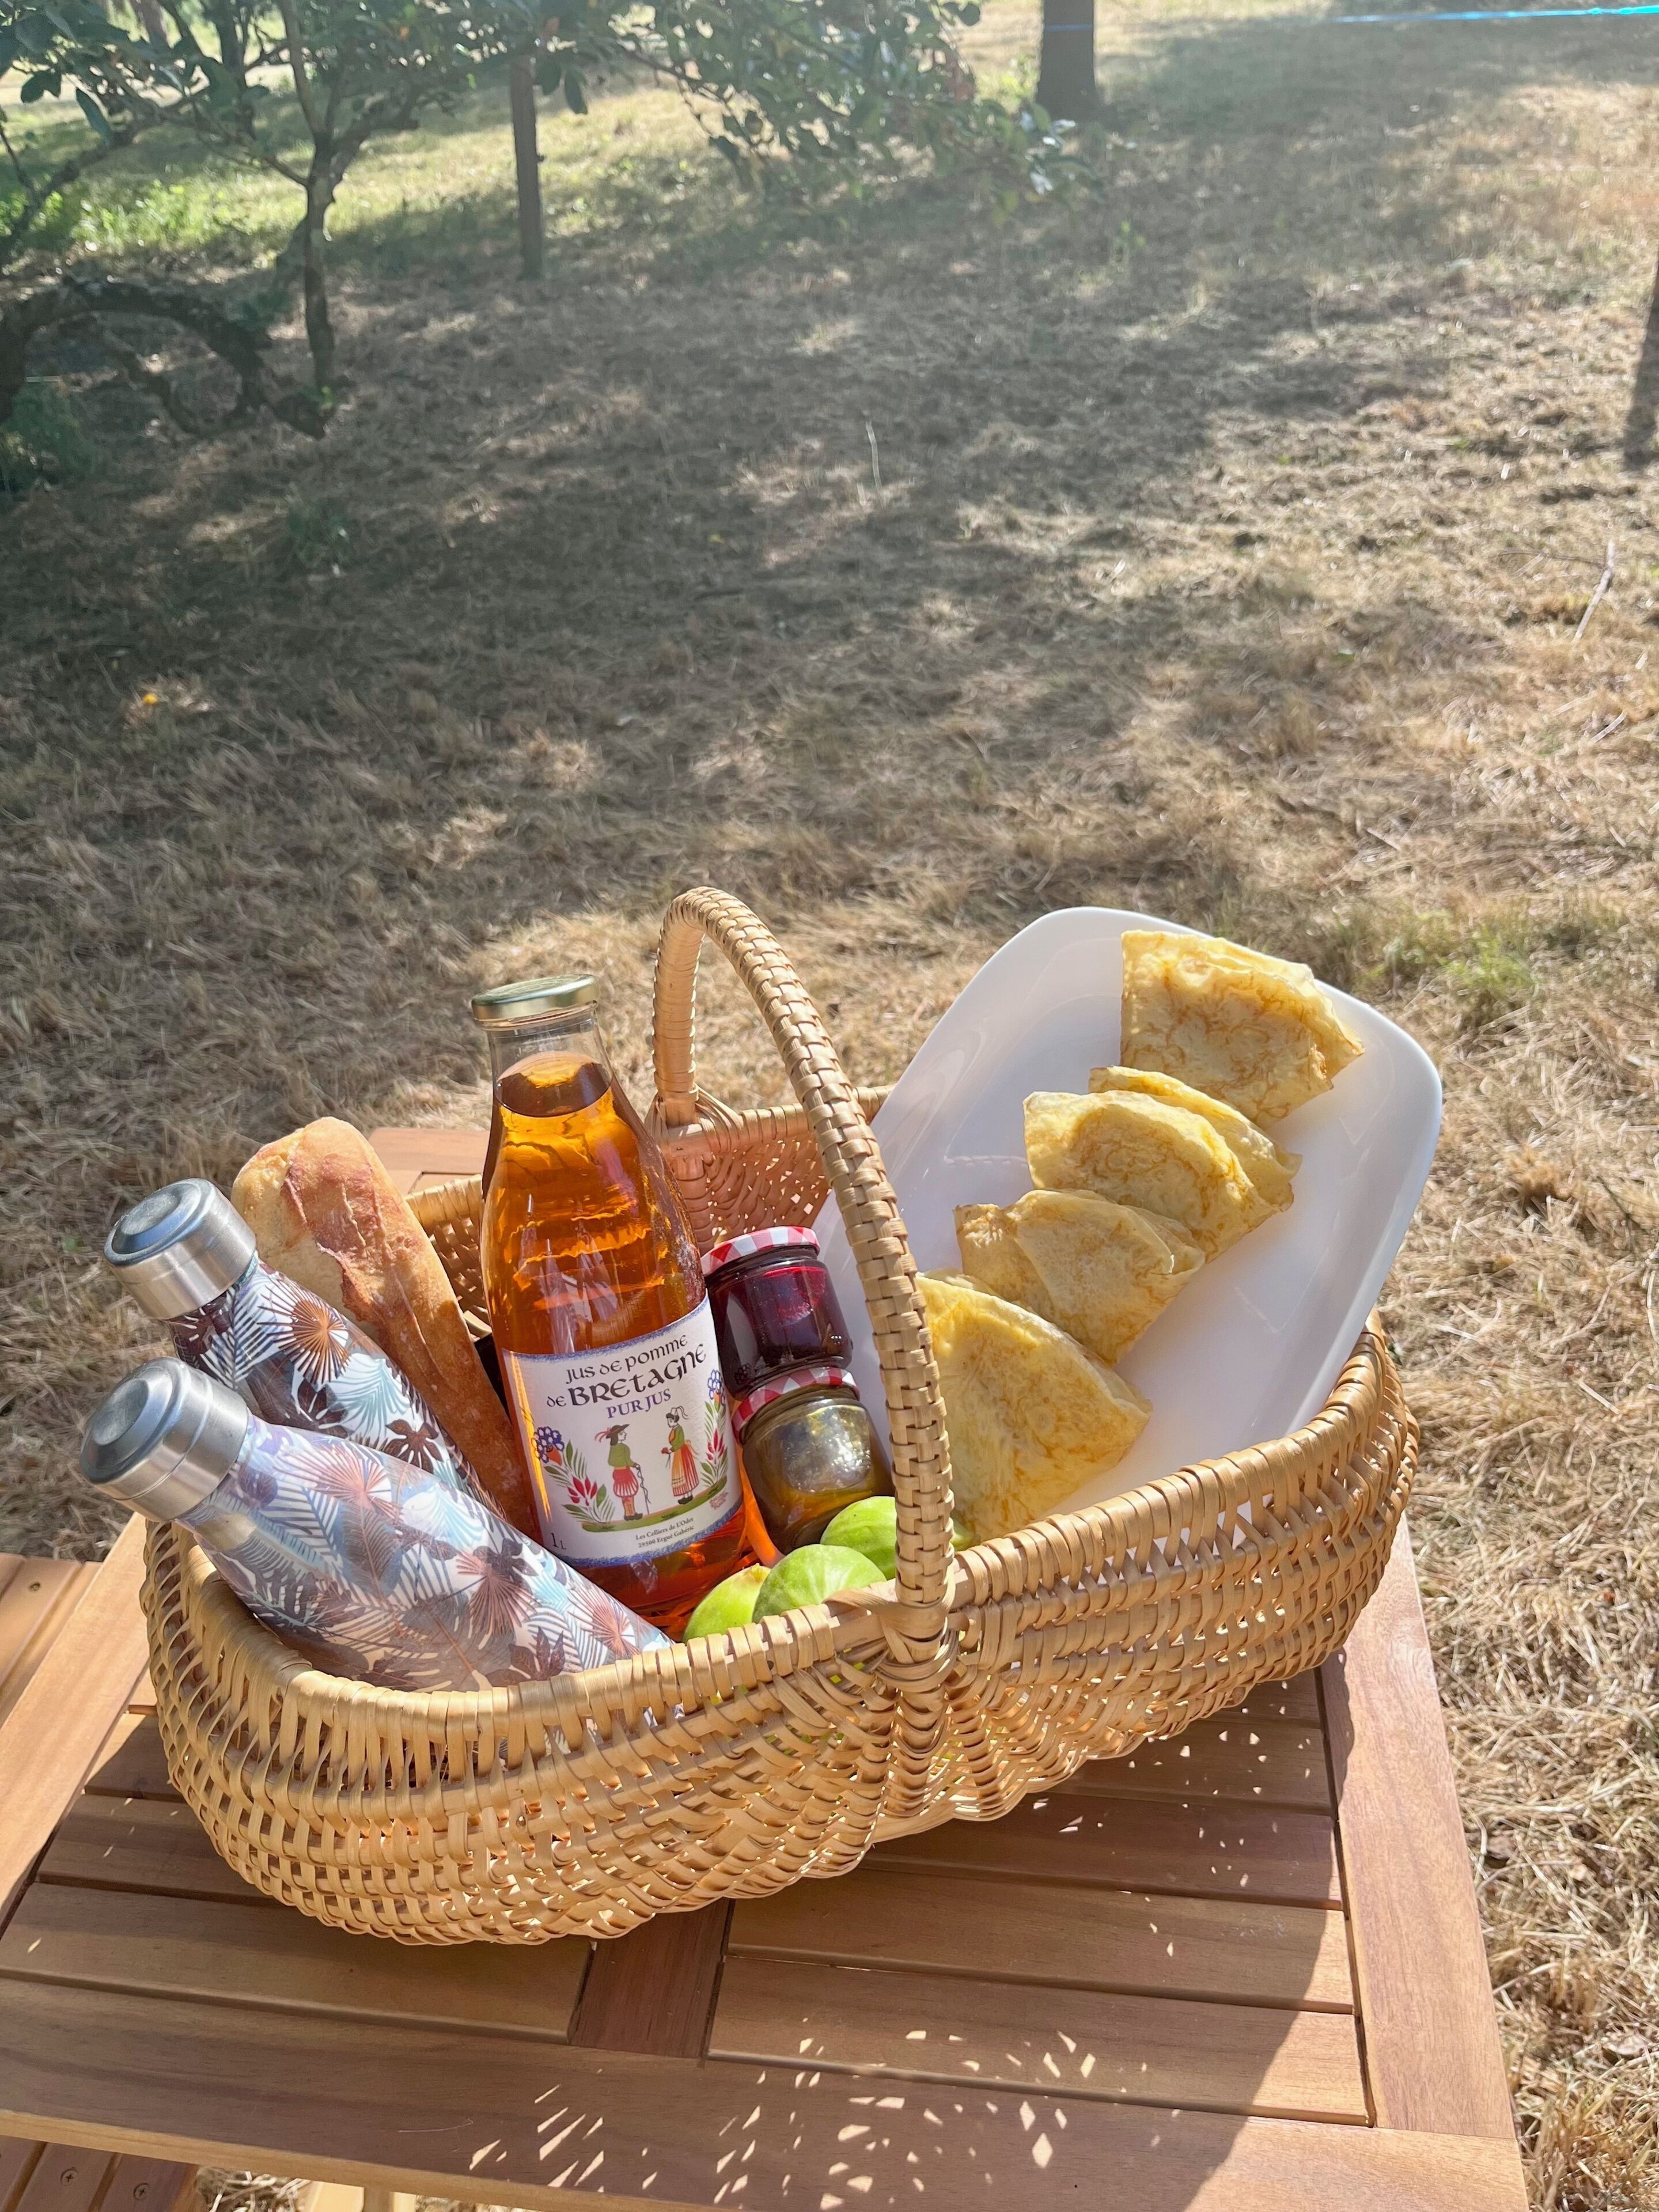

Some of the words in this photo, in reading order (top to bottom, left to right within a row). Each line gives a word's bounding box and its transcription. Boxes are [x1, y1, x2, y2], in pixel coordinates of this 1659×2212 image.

[606, 1400, 645, 1419] PUR
[645, 1388, 671, 1412] JUS
[646, 1527, 668, 1537] Celliers
[676, 1517, 694, 1528] L'Odet
[638, 1539, 656, 1548] 29500
[657, 1533, 673, 1543] Ergué
